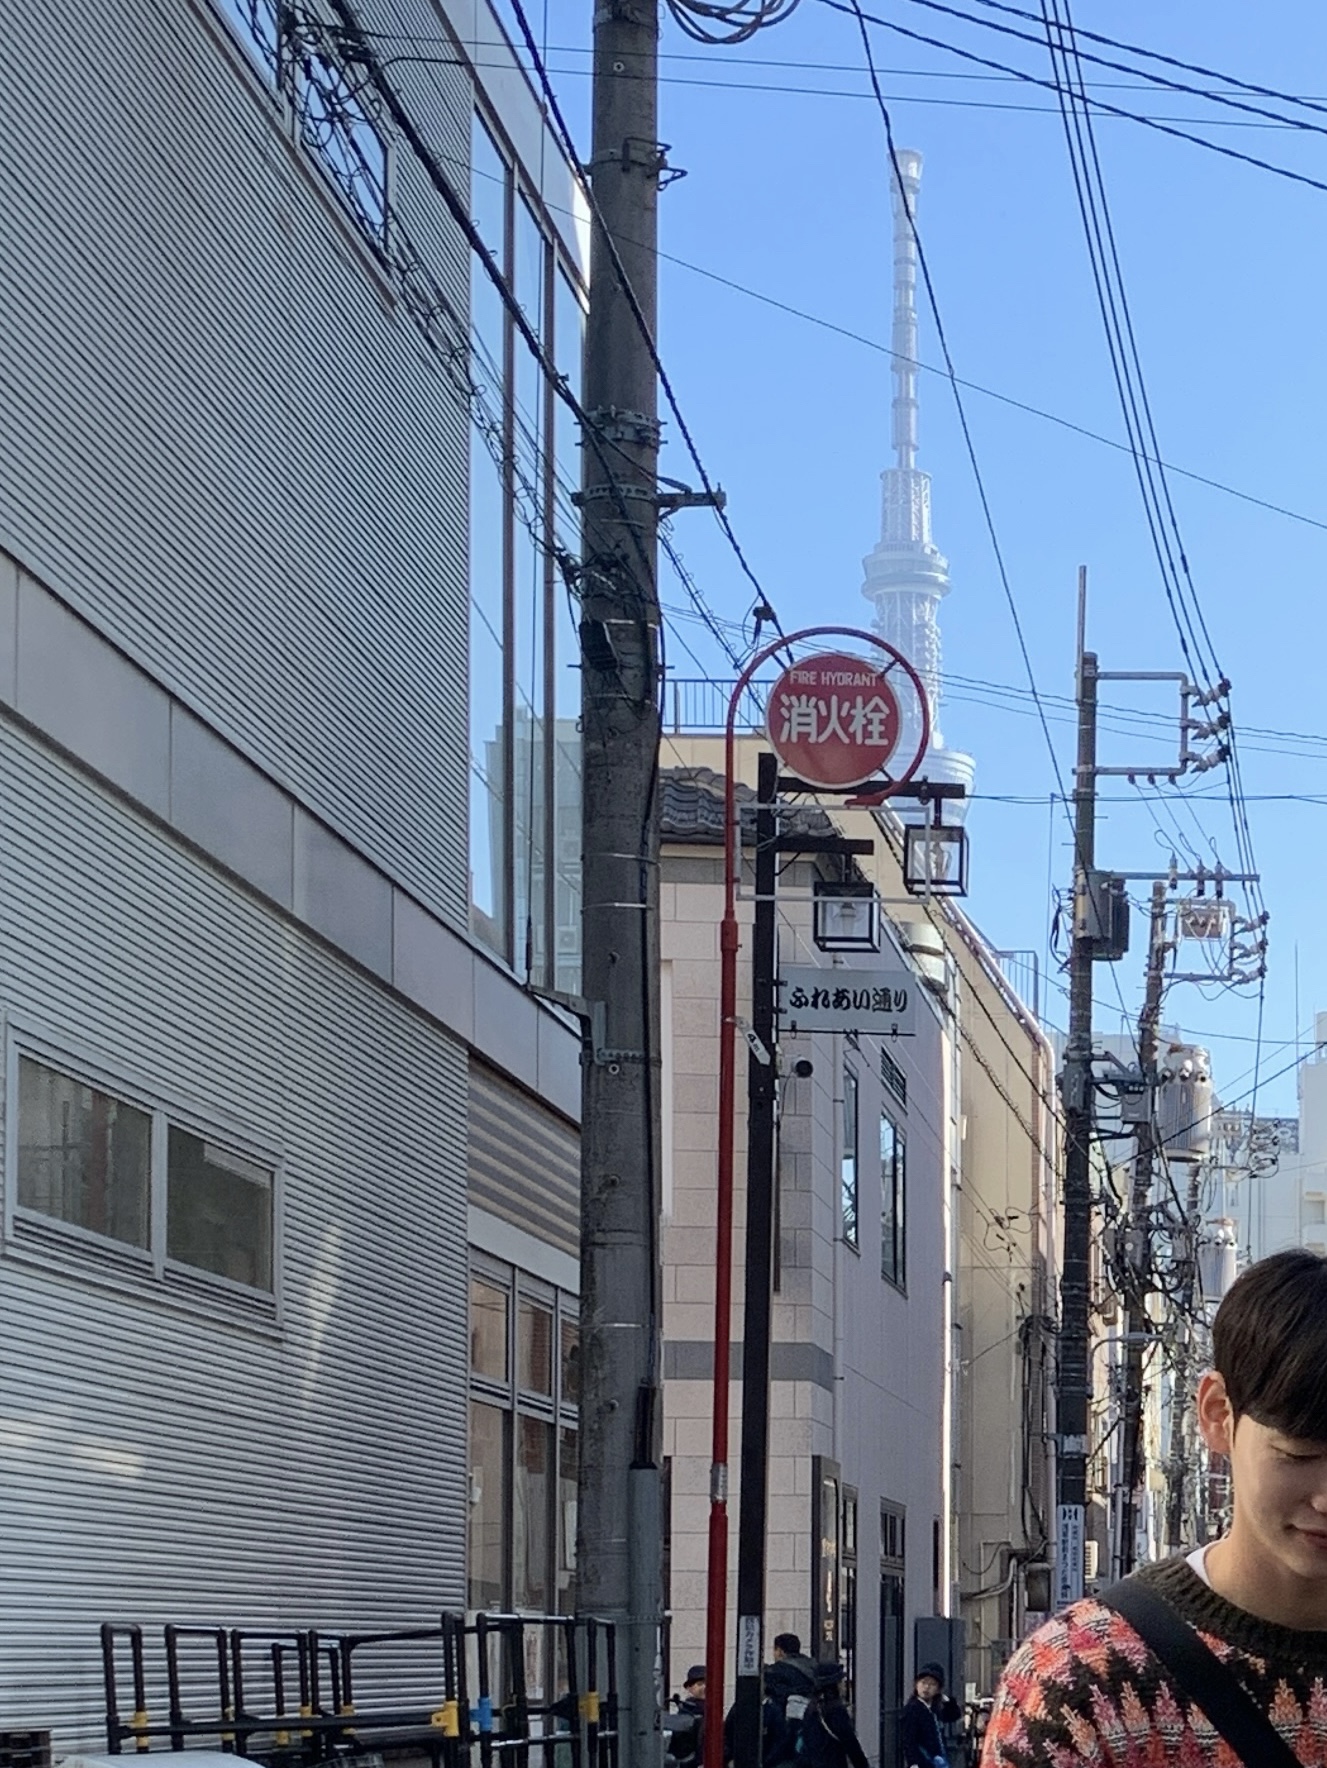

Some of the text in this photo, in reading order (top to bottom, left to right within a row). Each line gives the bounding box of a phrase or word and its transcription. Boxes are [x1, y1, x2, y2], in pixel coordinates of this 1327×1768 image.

[790, 670, 878, 688] FIRE HYDRANT
[779, 694, 891, 746] 消火栓
[789, 985, 908, 1013] ふれあい通り
